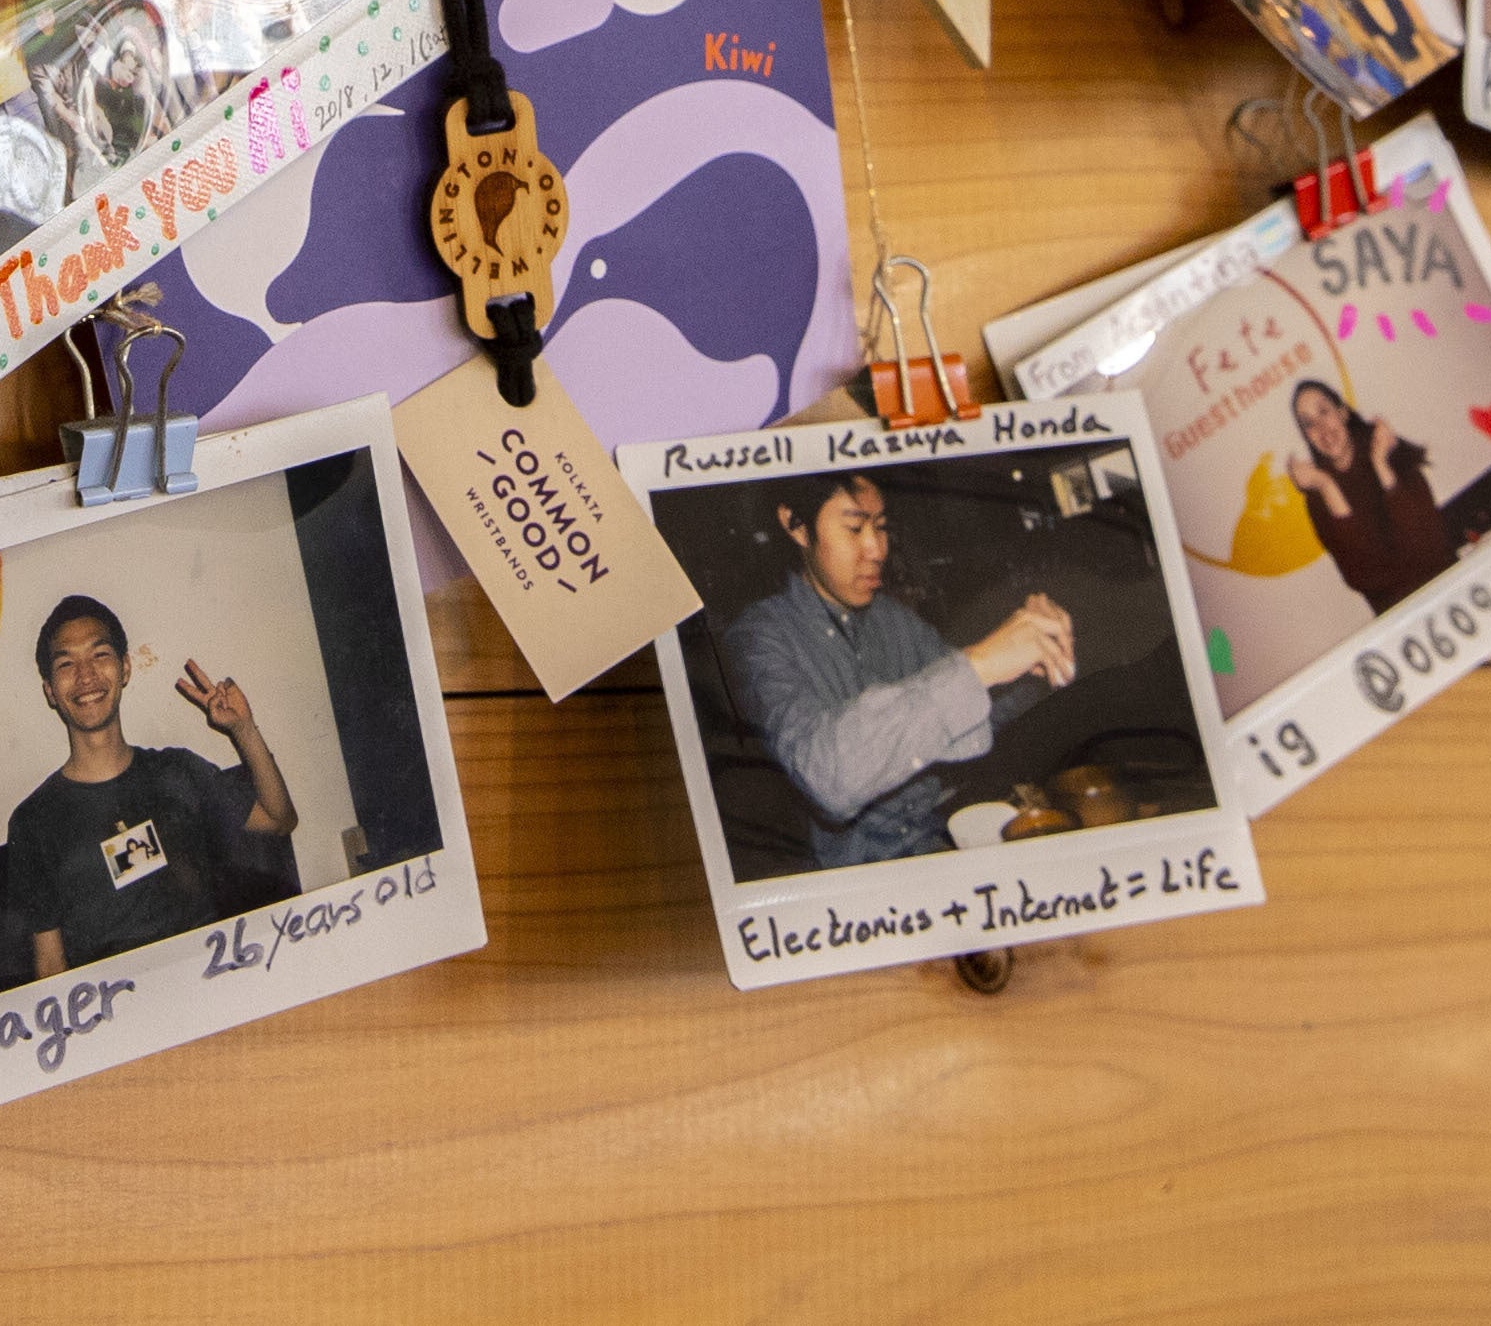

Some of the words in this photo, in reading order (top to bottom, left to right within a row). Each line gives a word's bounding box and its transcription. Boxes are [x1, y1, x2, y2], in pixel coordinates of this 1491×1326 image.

[704, 31, 777, 77] Kiwi
[140, 137, 238, 241] you
[1312, 220, 1465, 296] SAYA
[662, 436, 794, 477] Russell
[827, 426, 966, 464] Kazuya
[991, 404, 1113, 444] Honda
[501, 428, 609, 584] COMMON
[554, 451, 604, 523] KOLKATA
[465, 486, 535, 591] WRISTBANDS
[1246, 718, 1320, 779] ig
[200, 917, 266, 980] 26
[374, 855, 438, 907] old
[736, 907, 934, 963] Electronics
[973, 866, 1121, 932] Internet
[1161, 847, 1240, 894] Life
